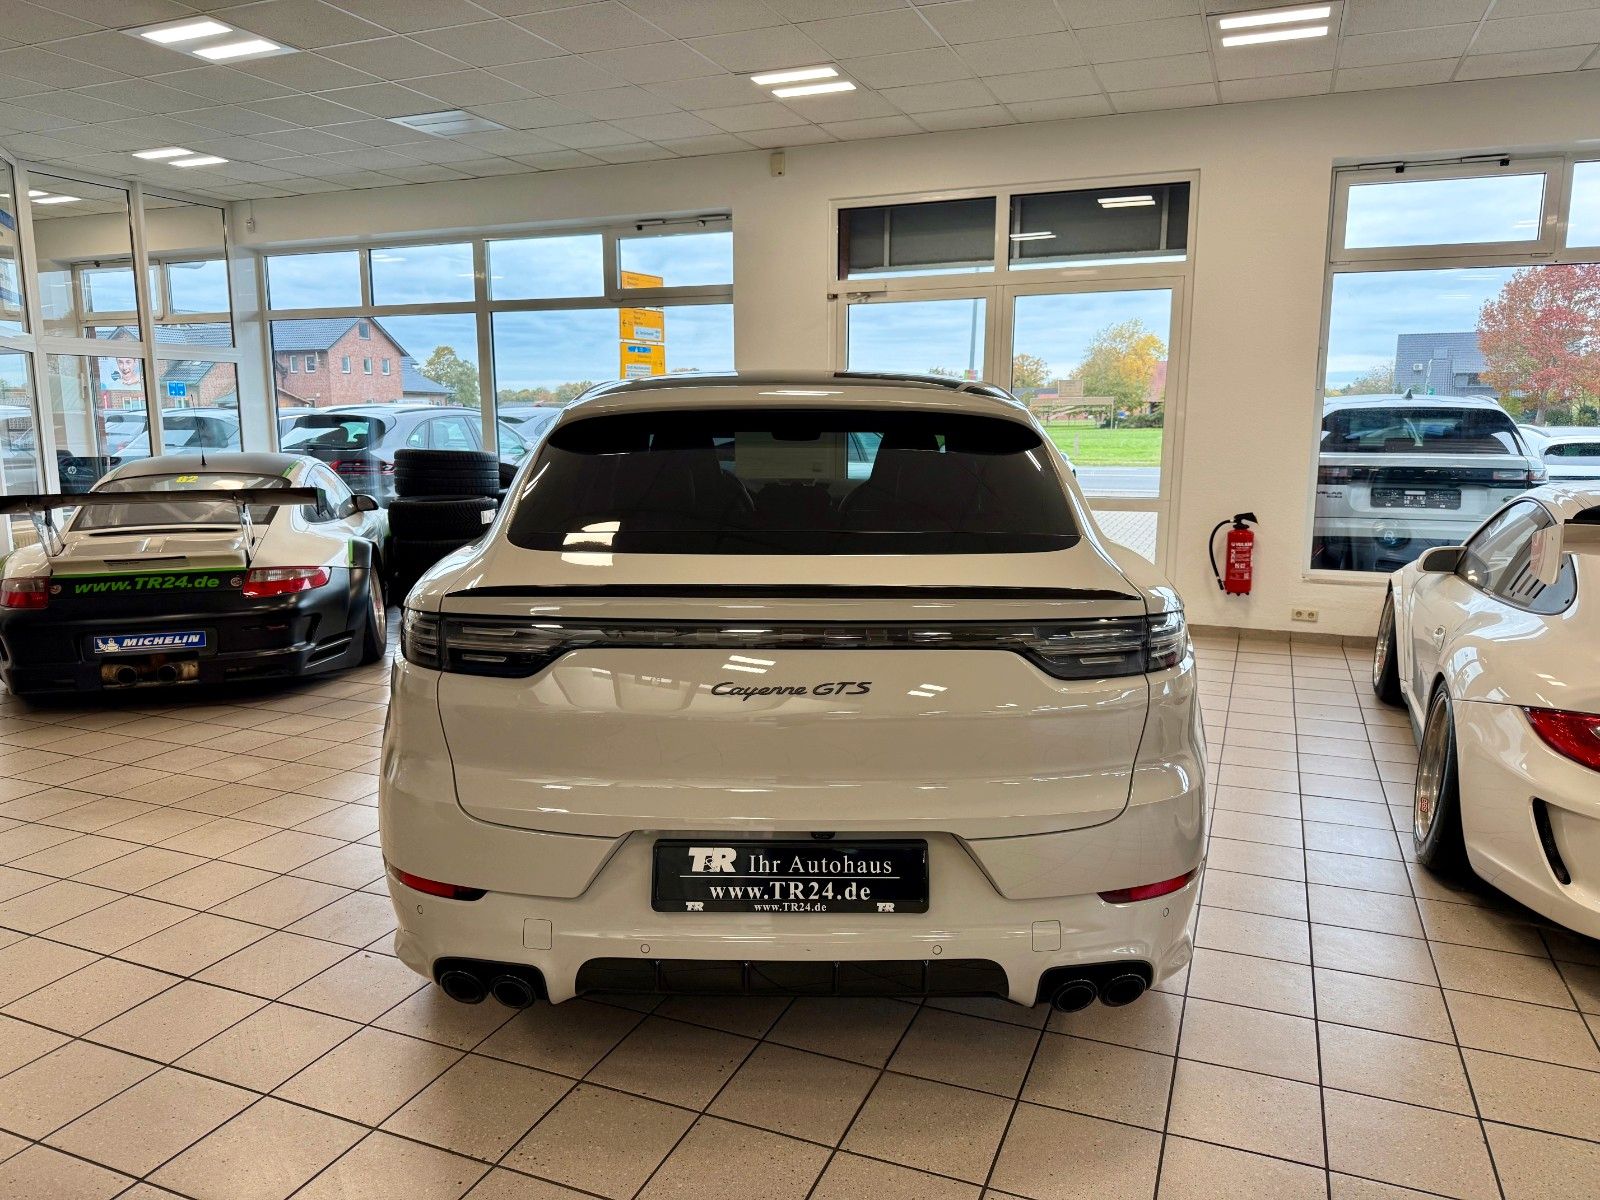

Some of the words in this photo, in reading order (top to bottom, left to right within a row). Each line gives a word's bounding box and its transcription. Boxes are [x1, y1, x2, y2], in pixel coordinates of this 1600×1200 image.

[74, 576, 220, 594] www.TR24.de
[122, 634, 200, 647] MICHELIN
[711, 682, 808, 701] Cayenne
[812, 681, 872, 696] GTS
[749, 855, 781, 874] Ihr
[788, 855, 893, 874] Autohaus
[709, 881, 872, 901] www.TR24.de
[754, 902, 827, 912] www.TR24.de
